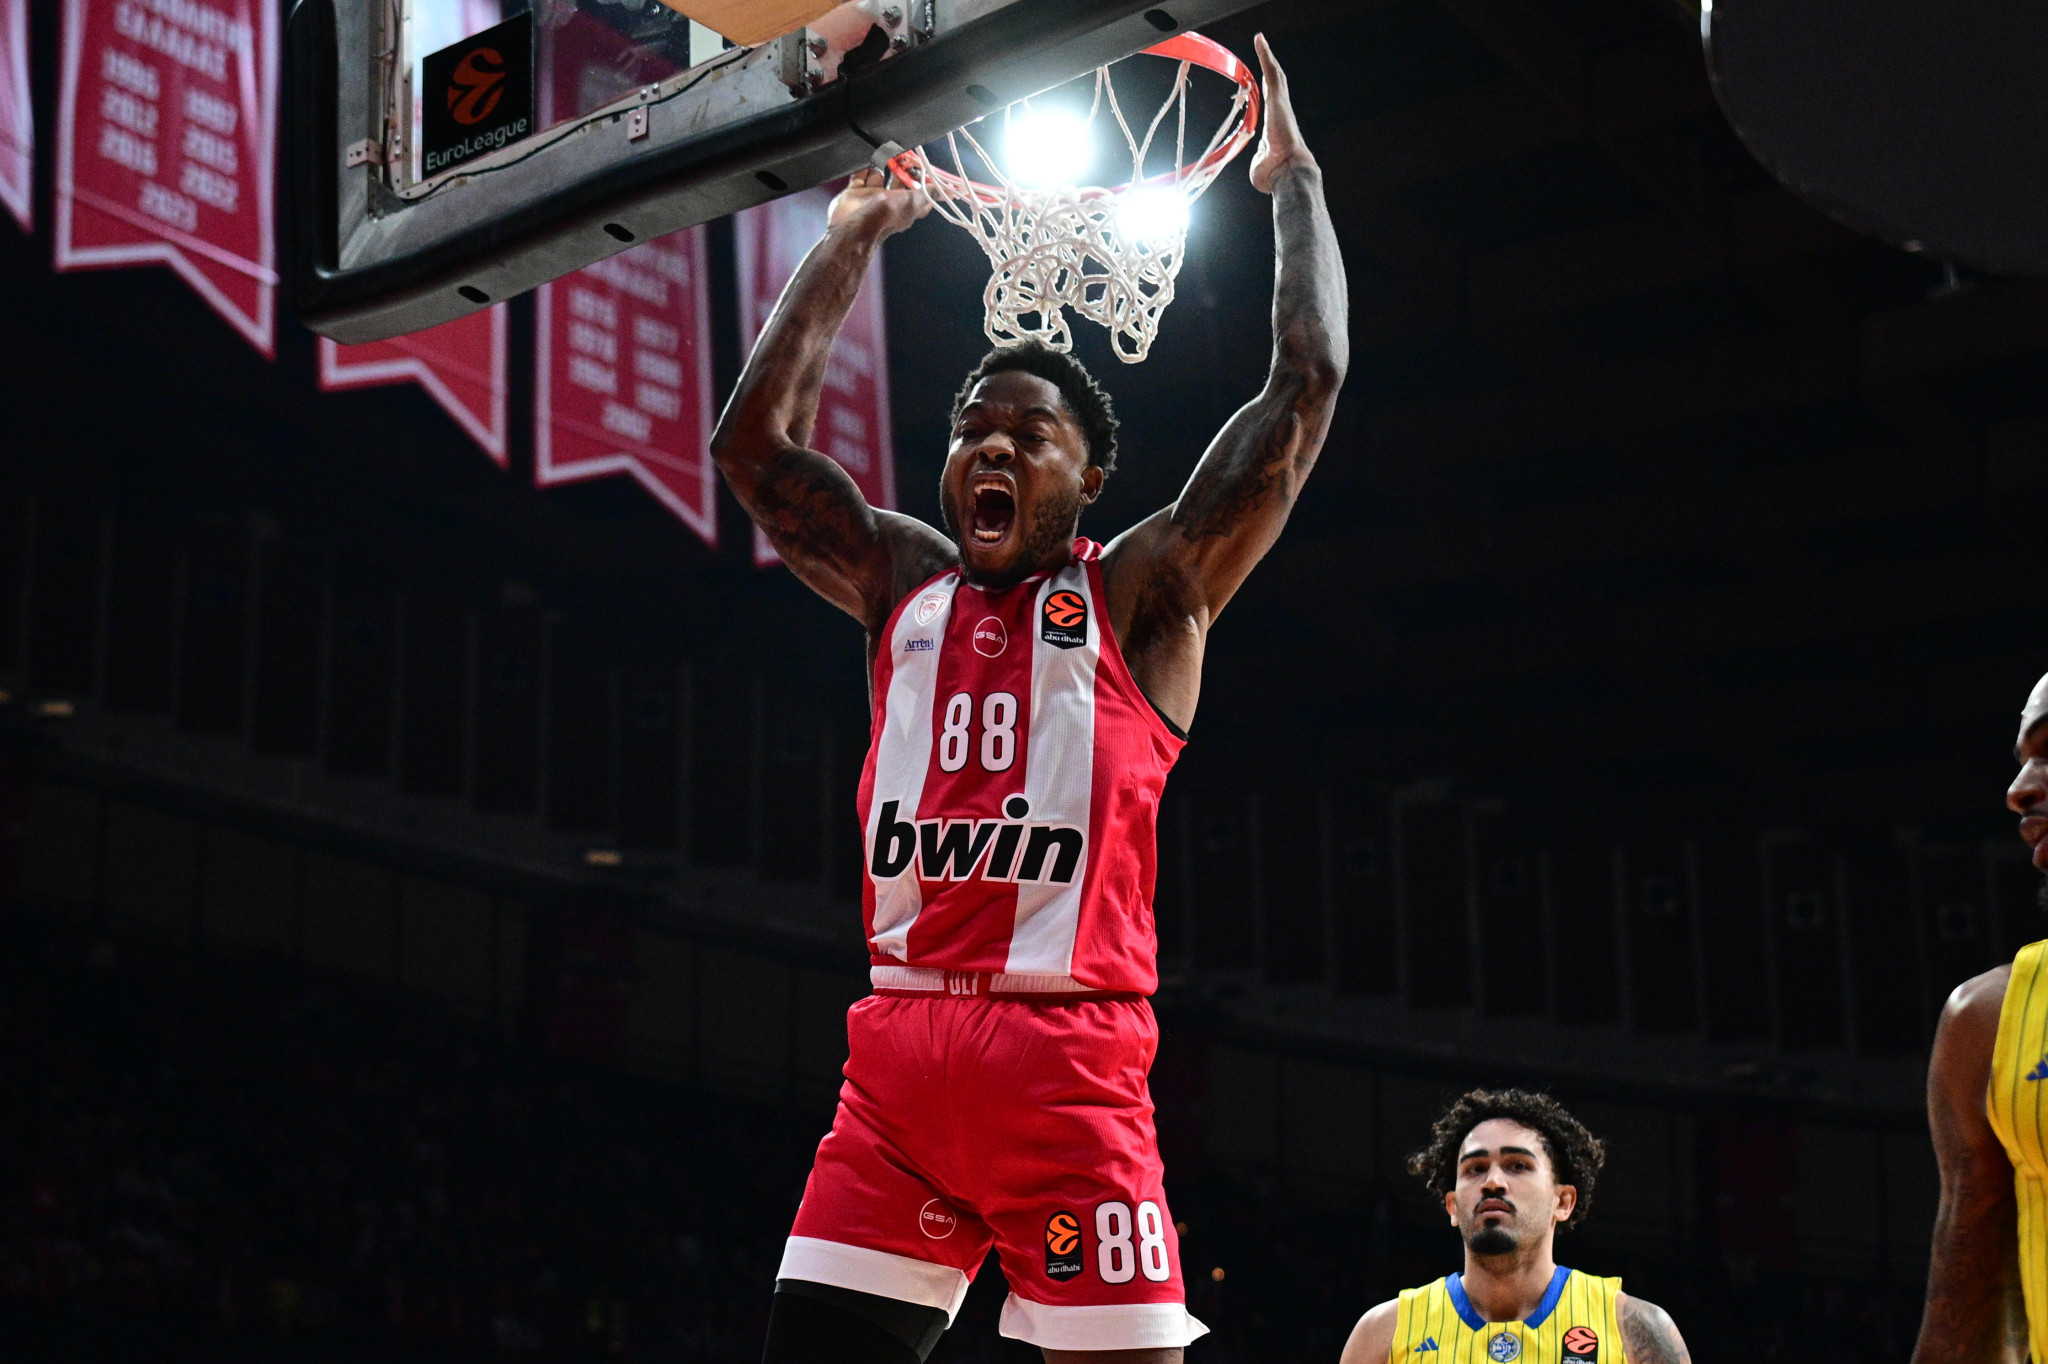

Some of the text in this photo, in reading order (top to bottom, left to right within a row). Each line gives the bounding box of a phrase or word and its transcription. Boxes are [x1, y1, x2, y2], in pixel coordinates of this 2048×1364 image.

[427, 118, 527, 171] EuroLeague
[975, 631, 1004, 644] GSA
[1044, 633, 1060, 641] abu
[1061, 635, 1084, 644] dhabi
[938, 691, 1019, 773] 88
[868, 795, 1086, 885] bwin
[923, 1212, 953, 1225] GSA
[1095, 1200, 1171, 1284] 88
[1047, 1265, 1060, 1273] abu
[1060, 1264, 1080, 1272] dhabi
